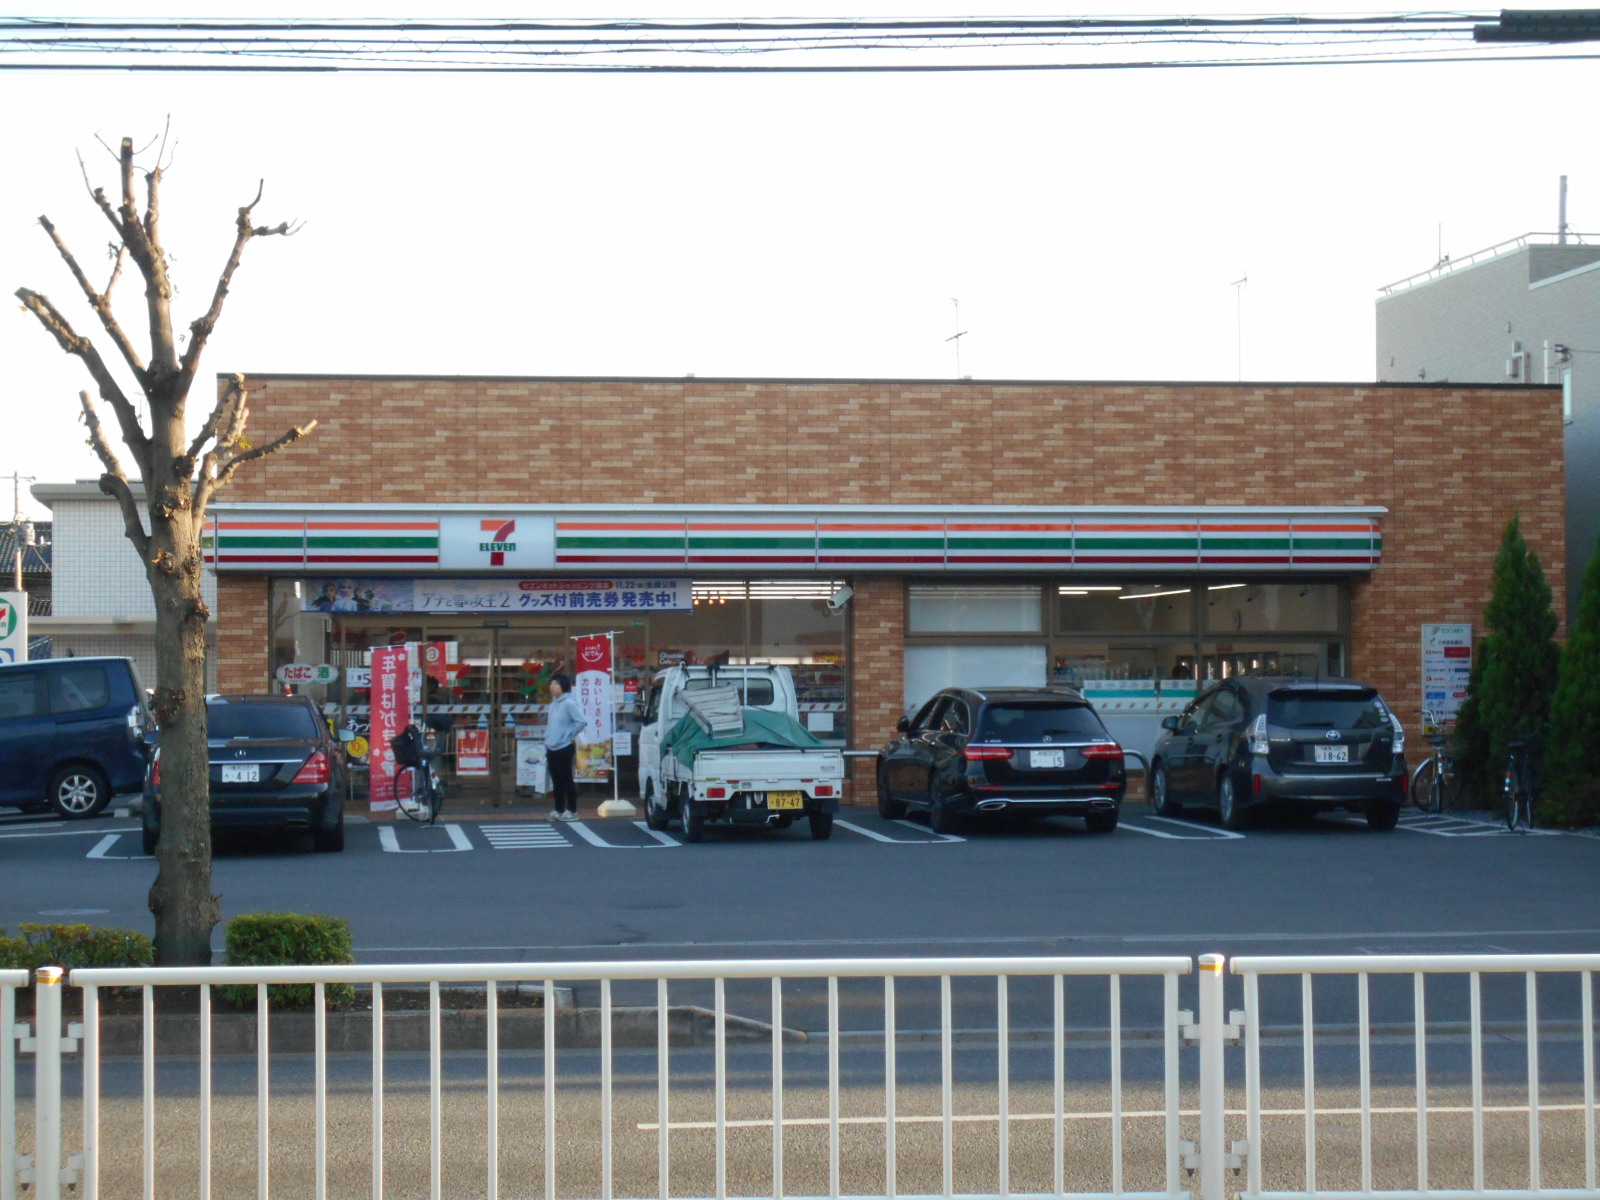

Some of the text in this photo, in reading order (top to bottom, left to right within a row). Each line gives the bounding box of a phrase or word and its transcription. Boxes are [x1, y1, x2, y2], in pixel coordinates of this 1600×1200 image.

[283, 667, 311, 679] たばこ
[317, 667, 329, 679] 酒
